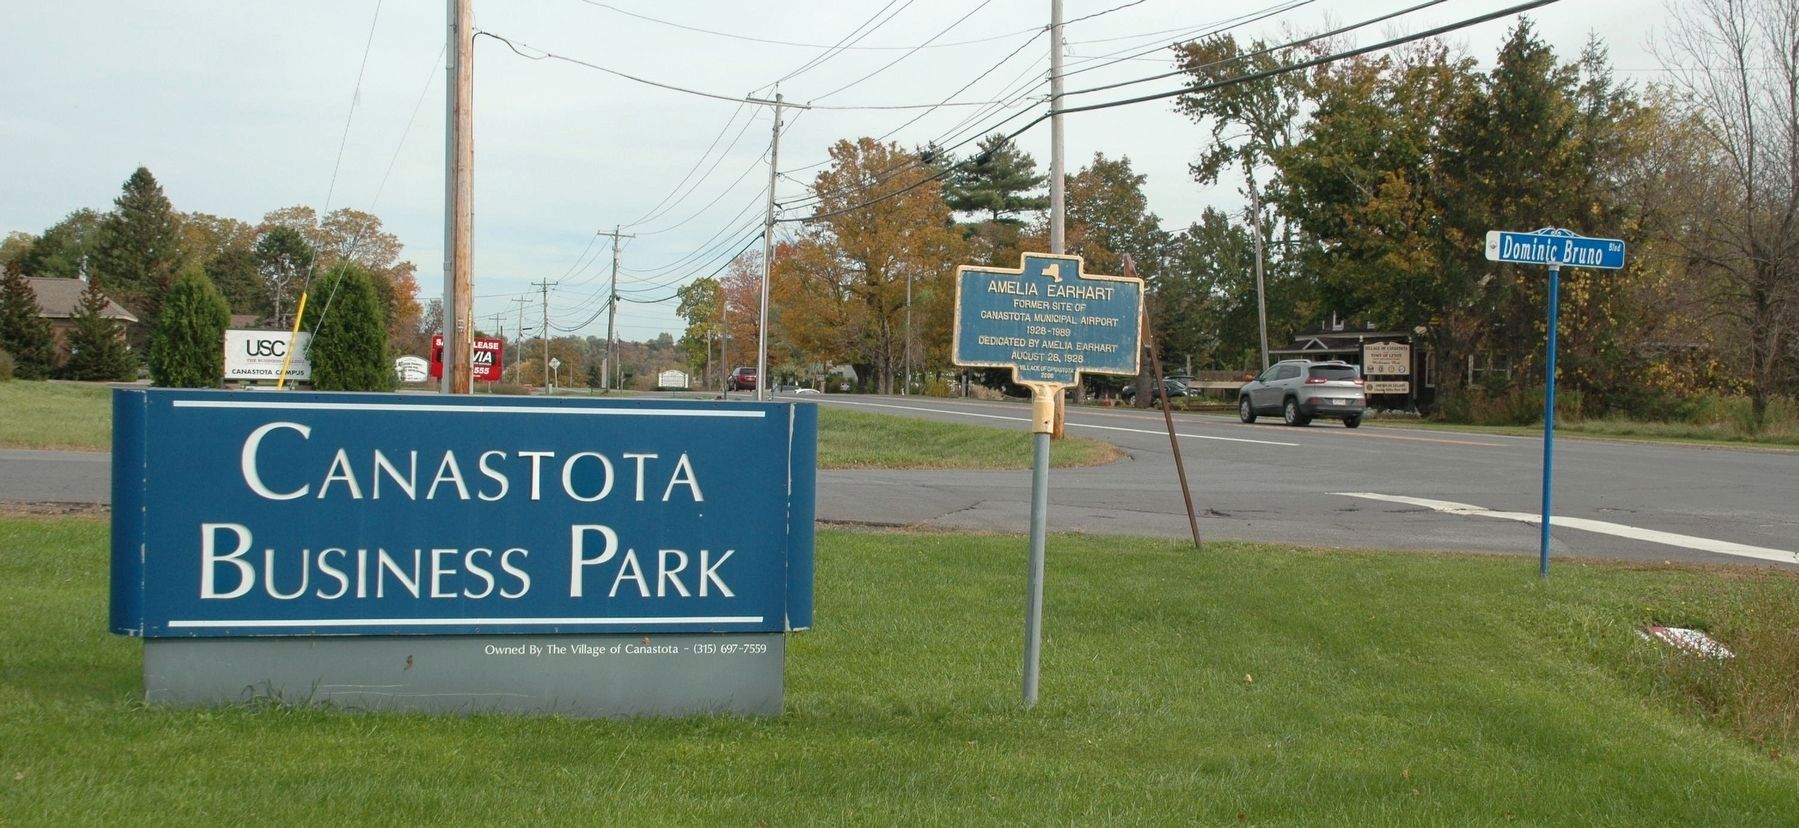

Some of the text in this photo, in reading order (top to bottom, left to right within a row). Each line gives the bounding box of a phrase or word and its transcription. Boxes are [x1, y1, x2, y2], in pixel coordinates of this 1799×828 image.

[1503, 235, 1621, 265] Dominic Bruno Blvd
[987, 280, 1114, 301] AMELIA EARHART
[1013, 299, 1086, 312] FORMER SITE OF
[980, 310, 1119, 327] CANASTOTA MUNICIPAL AIRPORT
[246, 339, 286, 357] USC
[473, 341, 499, 350] LEASE
[978, 335, 1118, 353] DEDICATED BY AMELIA EARHART
[1011, 351, 1084, 363] AUGUST 28, 1928
[240, 421, 704, 503] CANASTOTA
[199, 522, 737, 601] BUSINESS PARK
[484, 644, 526, 655] Owned
[529, 644, 543, 656] By
[546, 644, 567, 655] The
[570, 643, 606, 657] Village
[610, 643, 622, 655] of
[625, 643, 679, 655] Canastota
[693, 643, 717, 655] (315)
[720, 643, 767, 654] 697-7559
